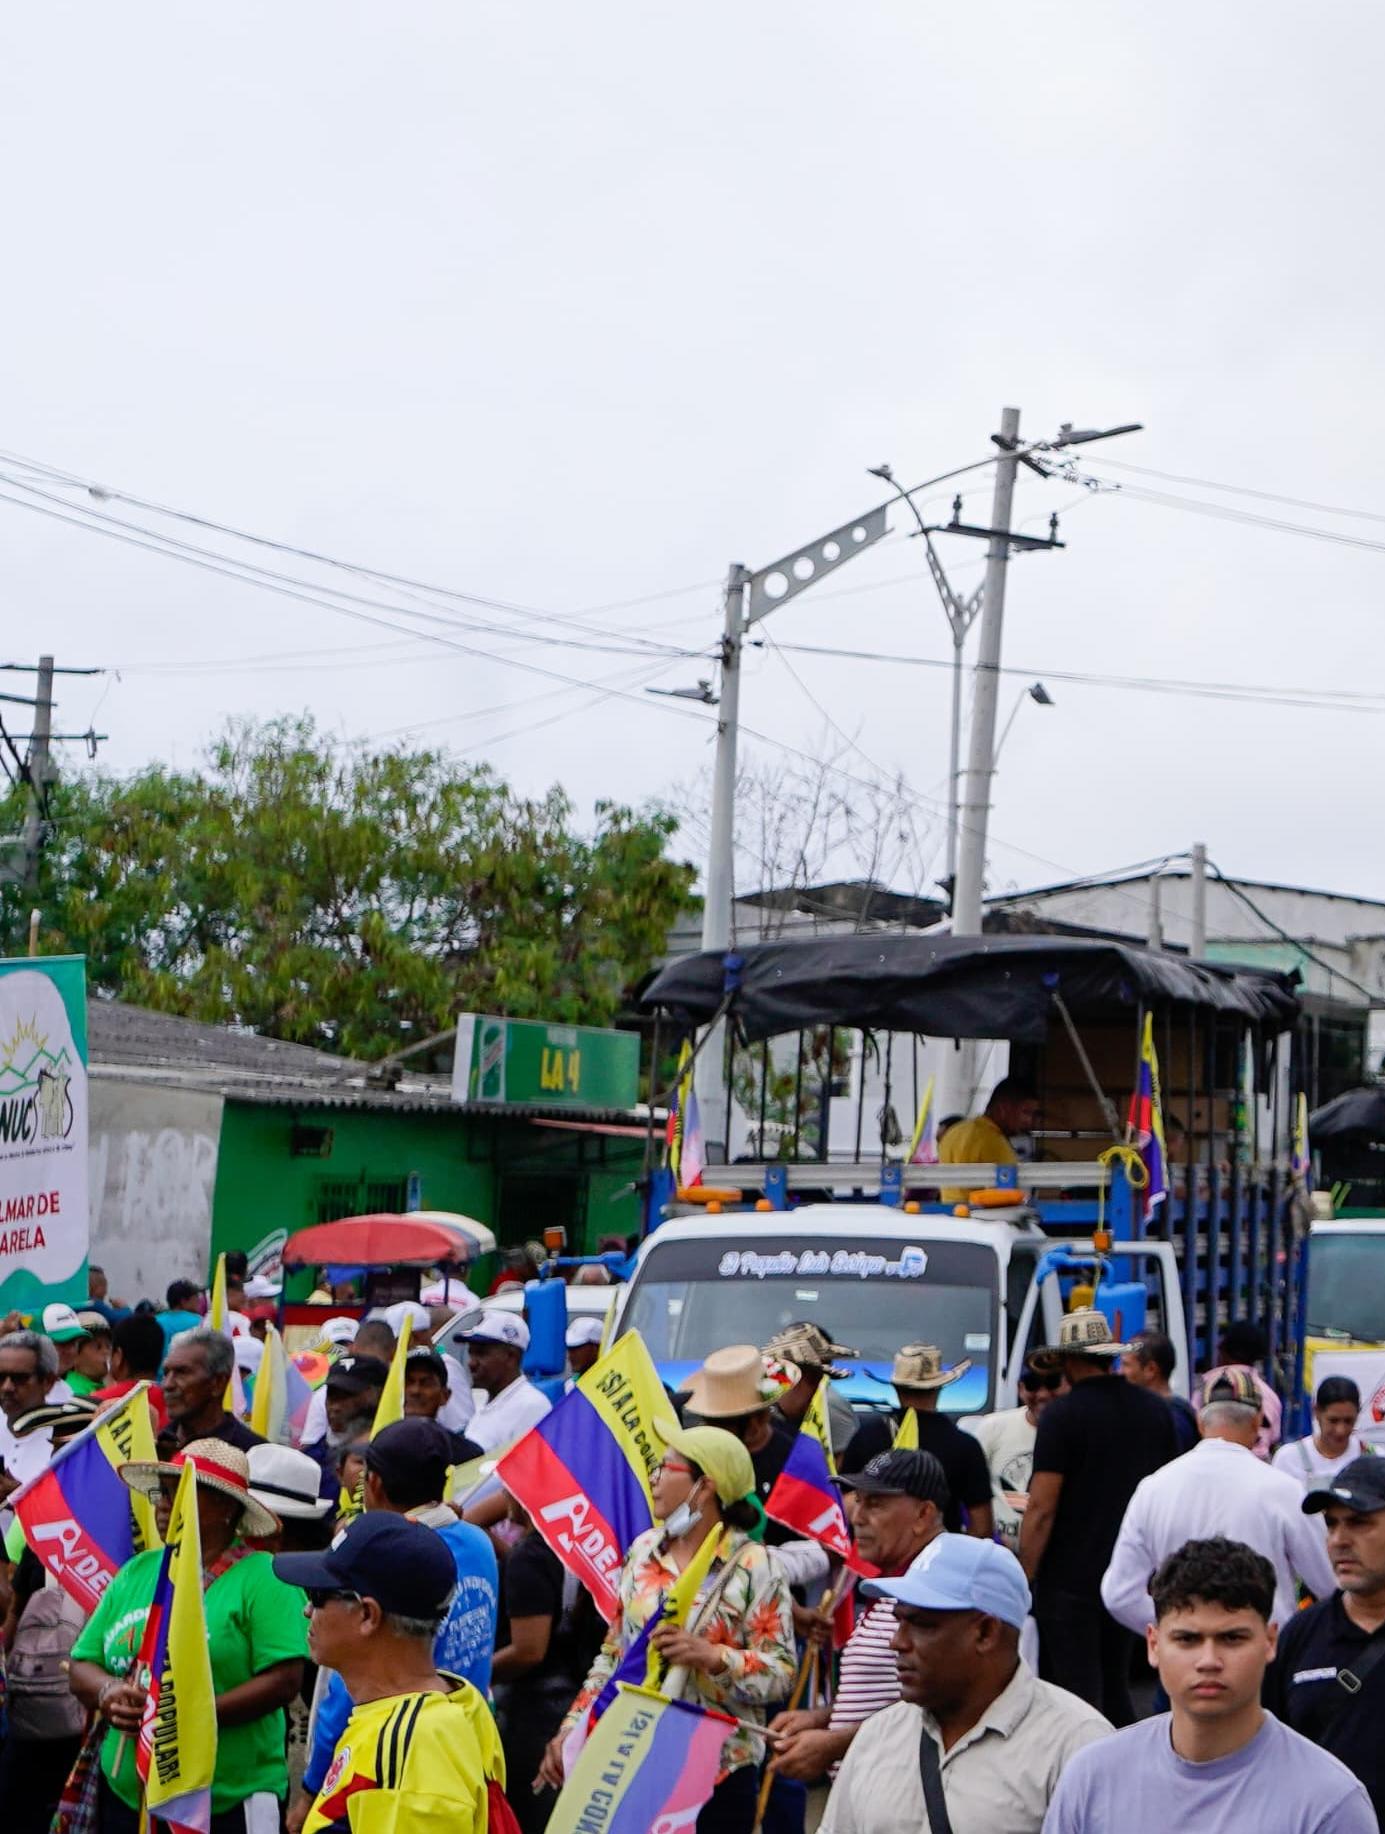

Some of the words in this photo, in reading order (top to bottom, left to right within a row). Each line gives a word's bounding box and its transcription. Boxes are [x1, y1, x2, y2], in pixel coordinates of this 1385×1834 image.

[540, 1047, 564, 1090] LA
[37, 1190, 60, 1216] DE
[611, 1391, 633, 1412] A
[620, 1405, 641, 1432] LA
[634, 1429, 659, 1474] CON
